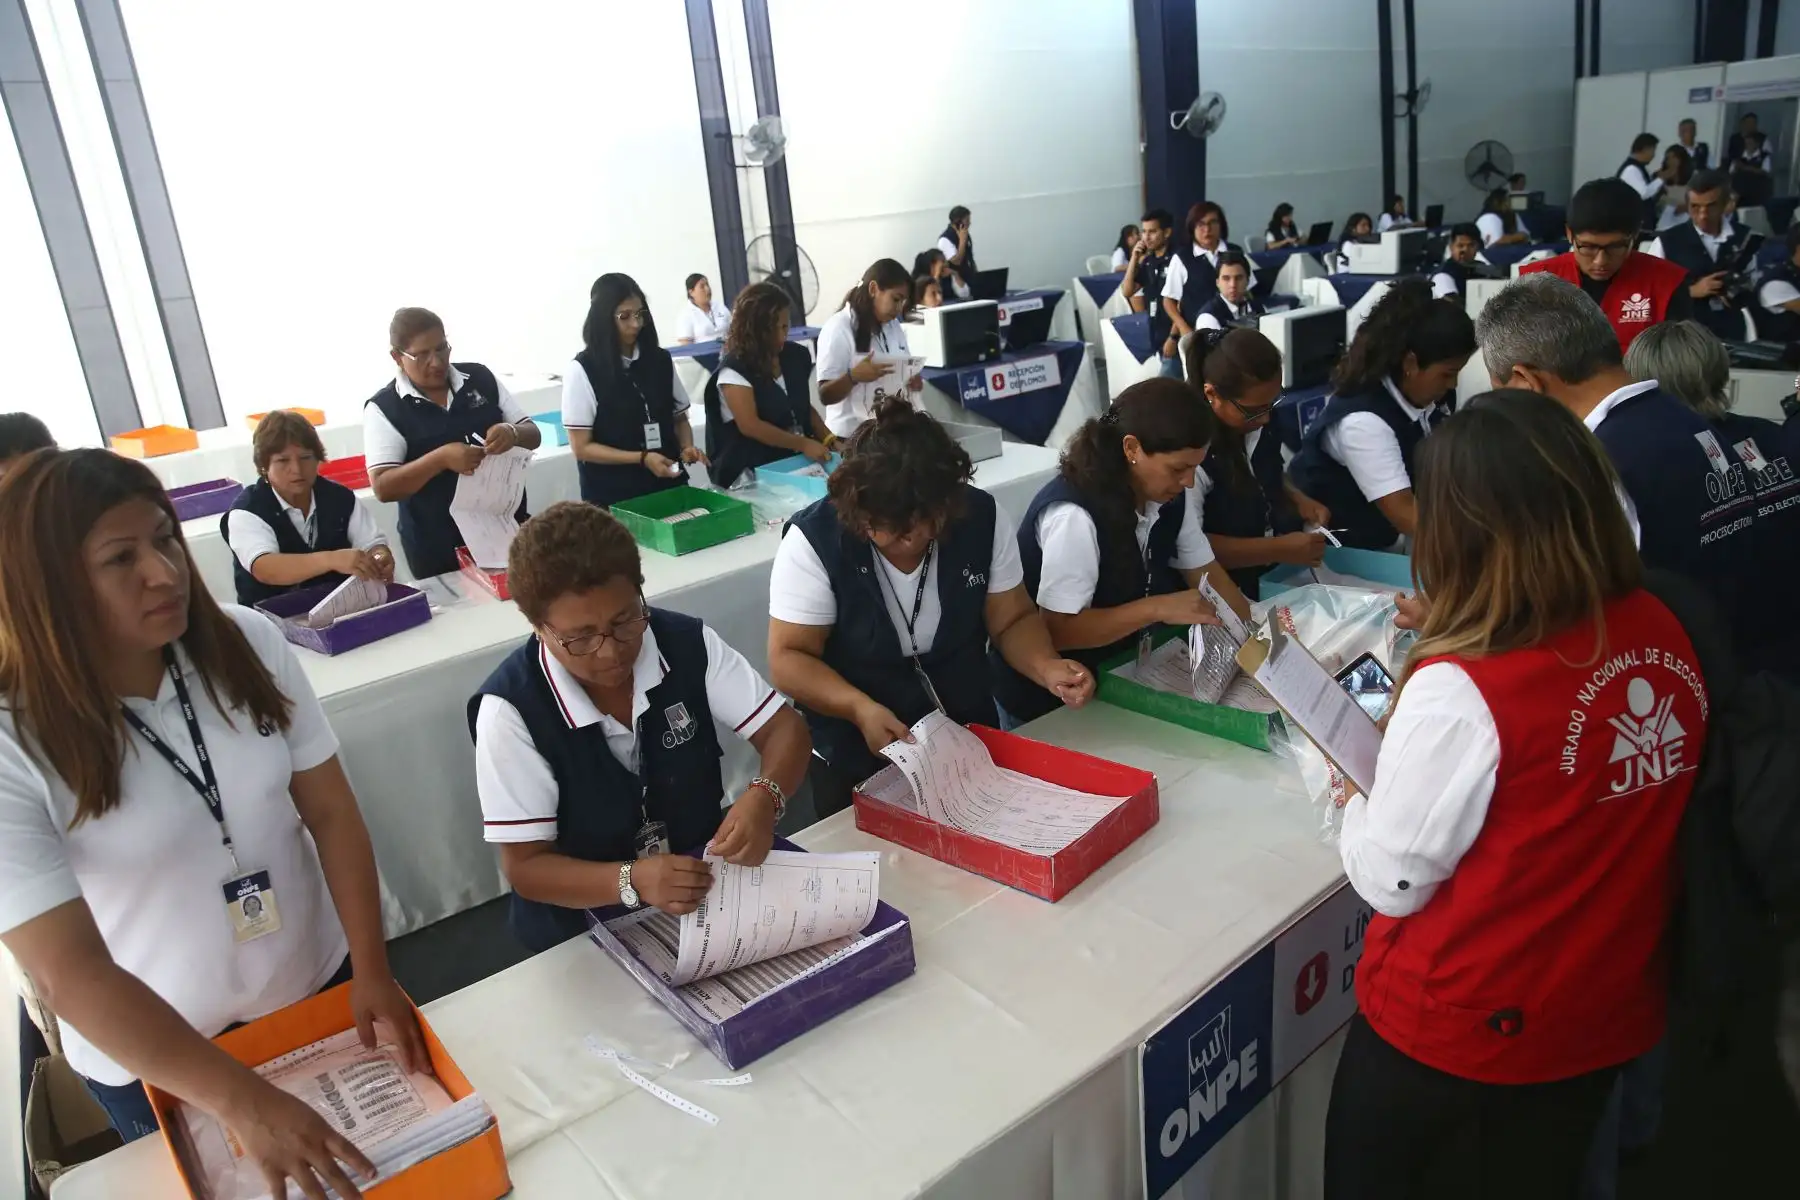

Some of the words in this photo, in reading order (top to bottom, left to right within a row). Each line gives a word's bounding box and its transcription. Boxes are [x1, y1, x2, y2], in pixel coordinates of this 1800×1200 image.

[1622, 310, 1649, 319] JNE
[1008, 364, 1046, 378] RECEPCIÓN
[964, 386, 987, 400] ONPE
[1754, 456, 1794, 490] NPE
[183, 703, 193, 720] ONPE
[1559, 709, 1586, 775] JURADO
[1576, 649, 1642, 706] NACIONAL
[1645, 648, 1660, 664] DE
[140, 727, 157, 742] ONPE
[197, 744, 207, 761] ONPE
[174, 759, 188, 774] ONPE
[1611, 740, 1685, 793] JNE
[237, 883, 259, 897] ONPE
[1159, 1038, 1258, 1158] ONPE
